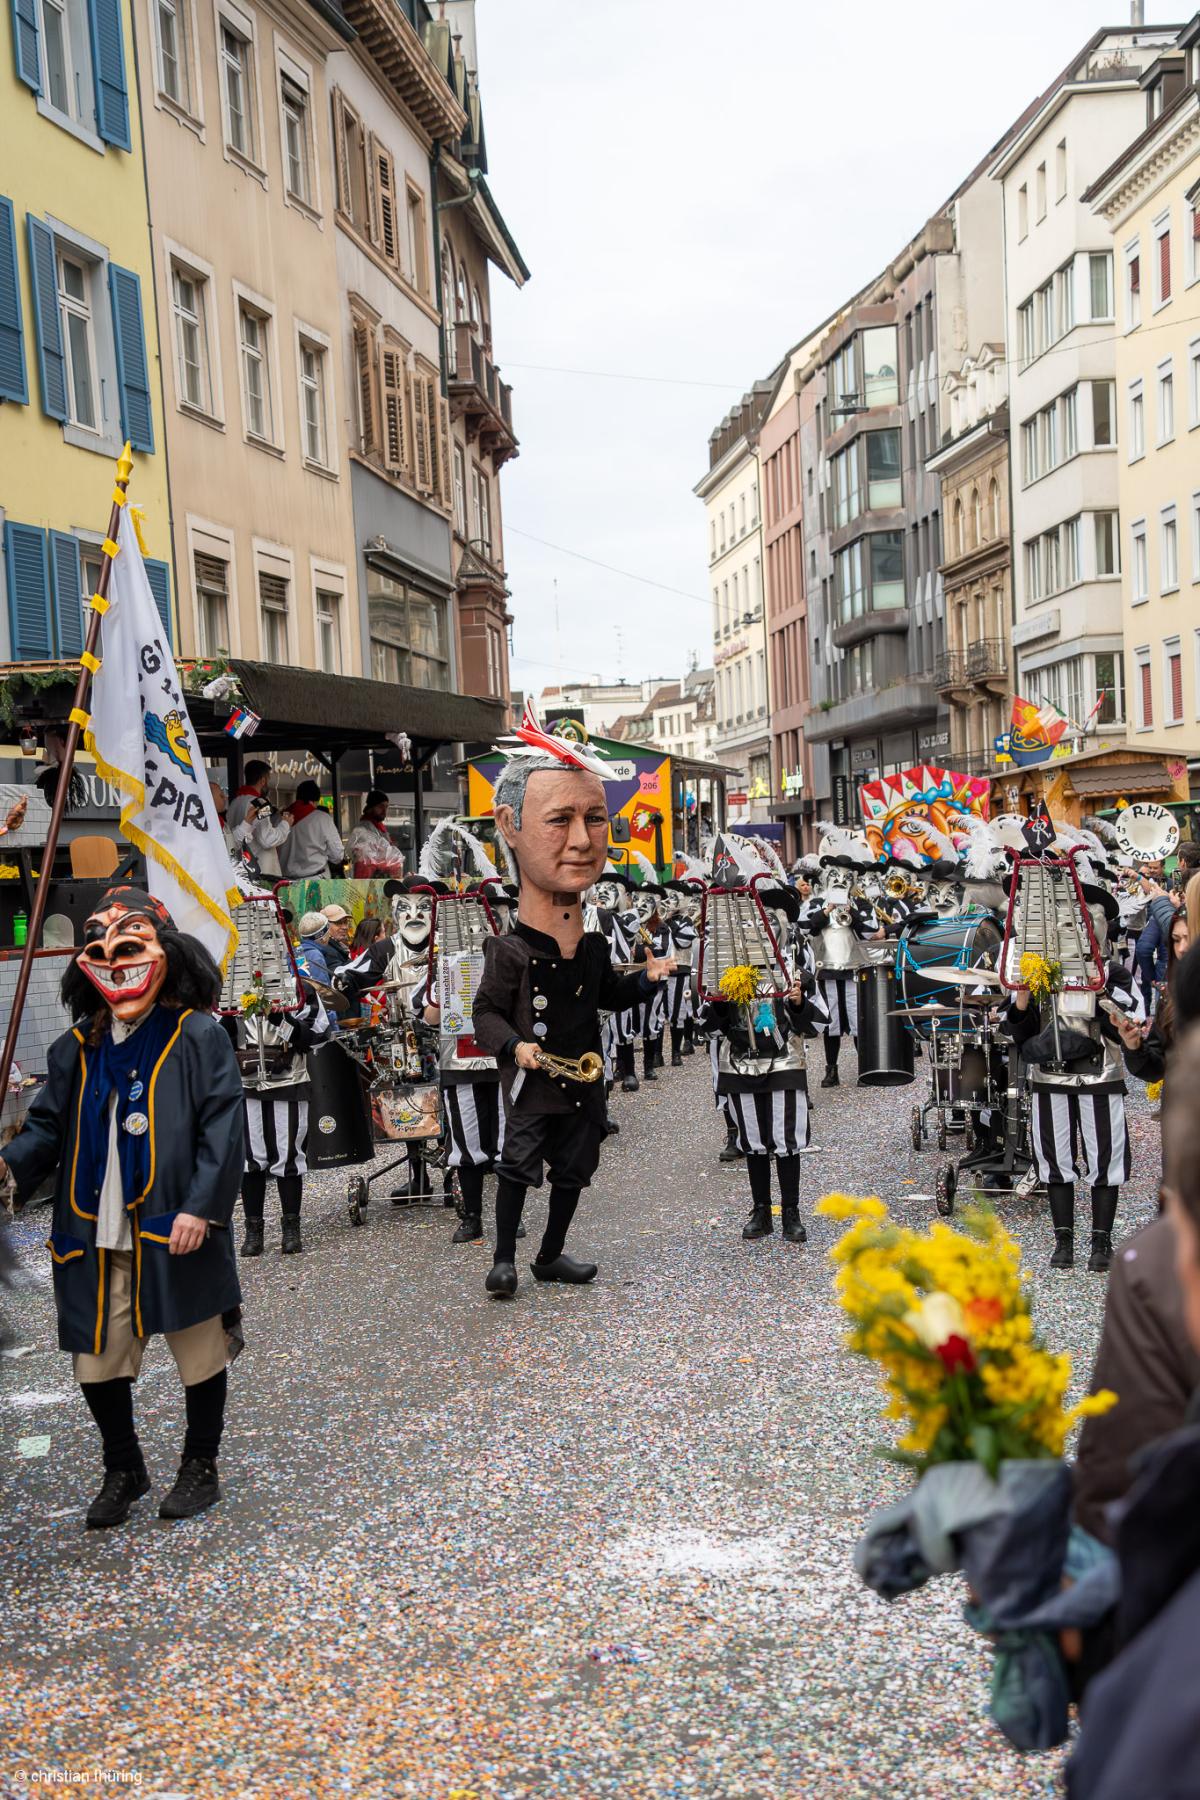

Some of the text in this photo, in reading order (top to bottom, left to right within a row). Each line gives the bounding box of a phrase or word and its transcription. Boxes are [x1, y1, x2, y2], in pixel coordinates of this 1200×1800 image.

[643, 782, 658, 790] 206
[1132, 805, 1169, 820] RHY
[1120, 838, 1170, 860] PIRATE
